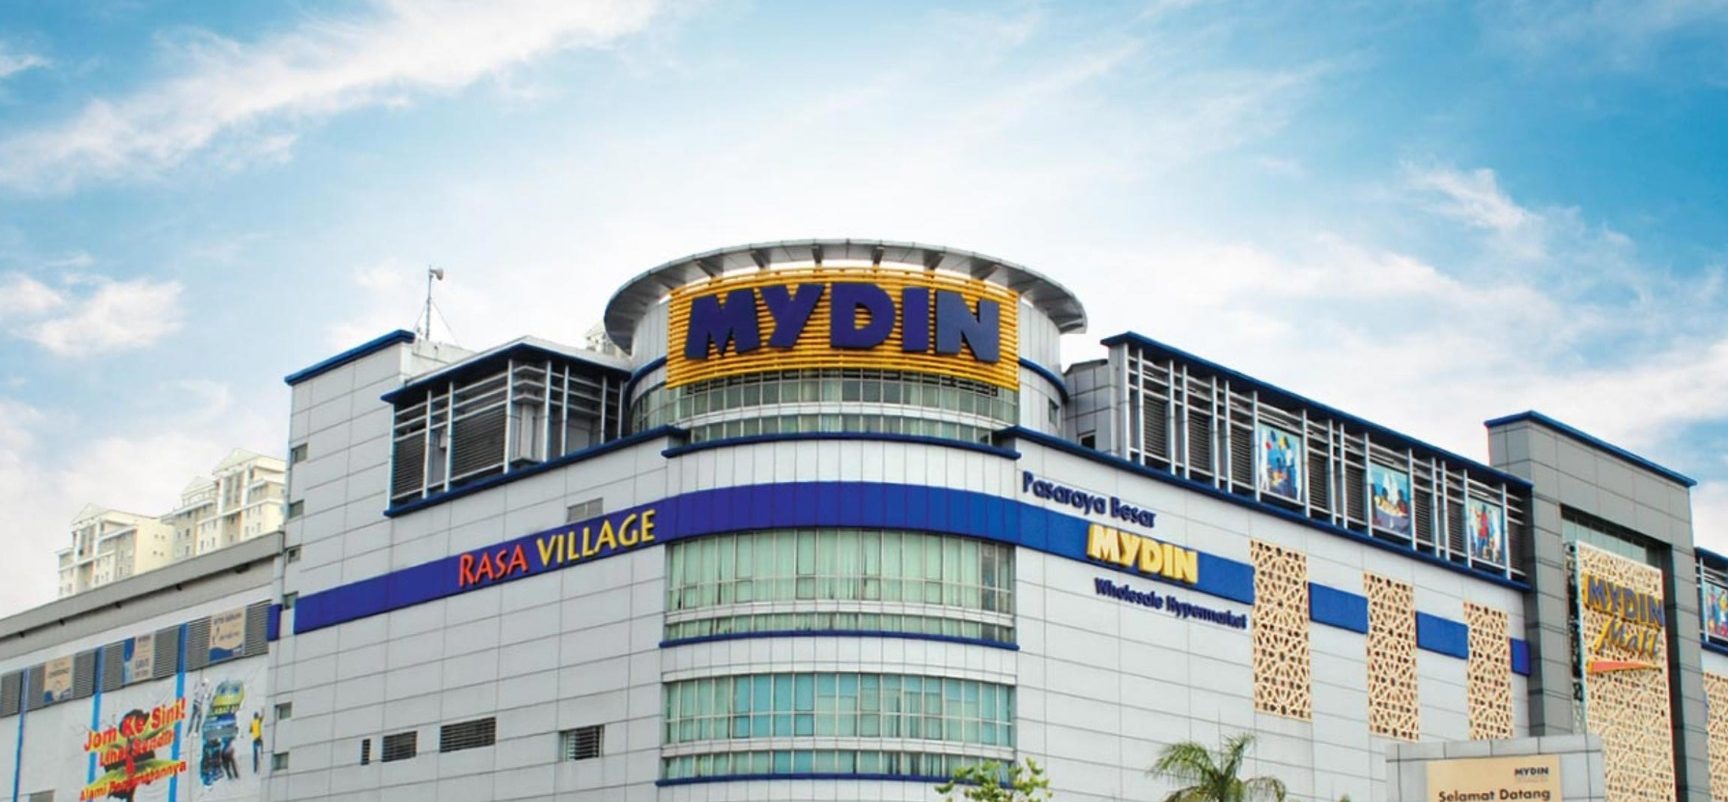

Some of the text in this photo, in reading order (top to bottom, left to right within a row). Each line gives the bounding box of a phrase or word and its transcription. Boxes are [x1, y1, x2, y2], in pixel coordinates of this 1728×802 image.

[684, 281, 1000, 363] MYDIN
[1022, 470, 1157, 528] Pasaraya Besar
[459, 509, 656, 587] RASA VILLAGE
[1086, 522, 1199, 585] MYDIN
[1094, 577, 1247, 629] Wholesale Hypermarket
[1582, 574, 1665, 630] MYDIN
[1594, 617, 1661, 658] Mall
[84, 727, 117, 751] Jom
[1438, 789, 1550, 802] Selamat Datang
[1514, 767, 1549, 776] MYDIN
